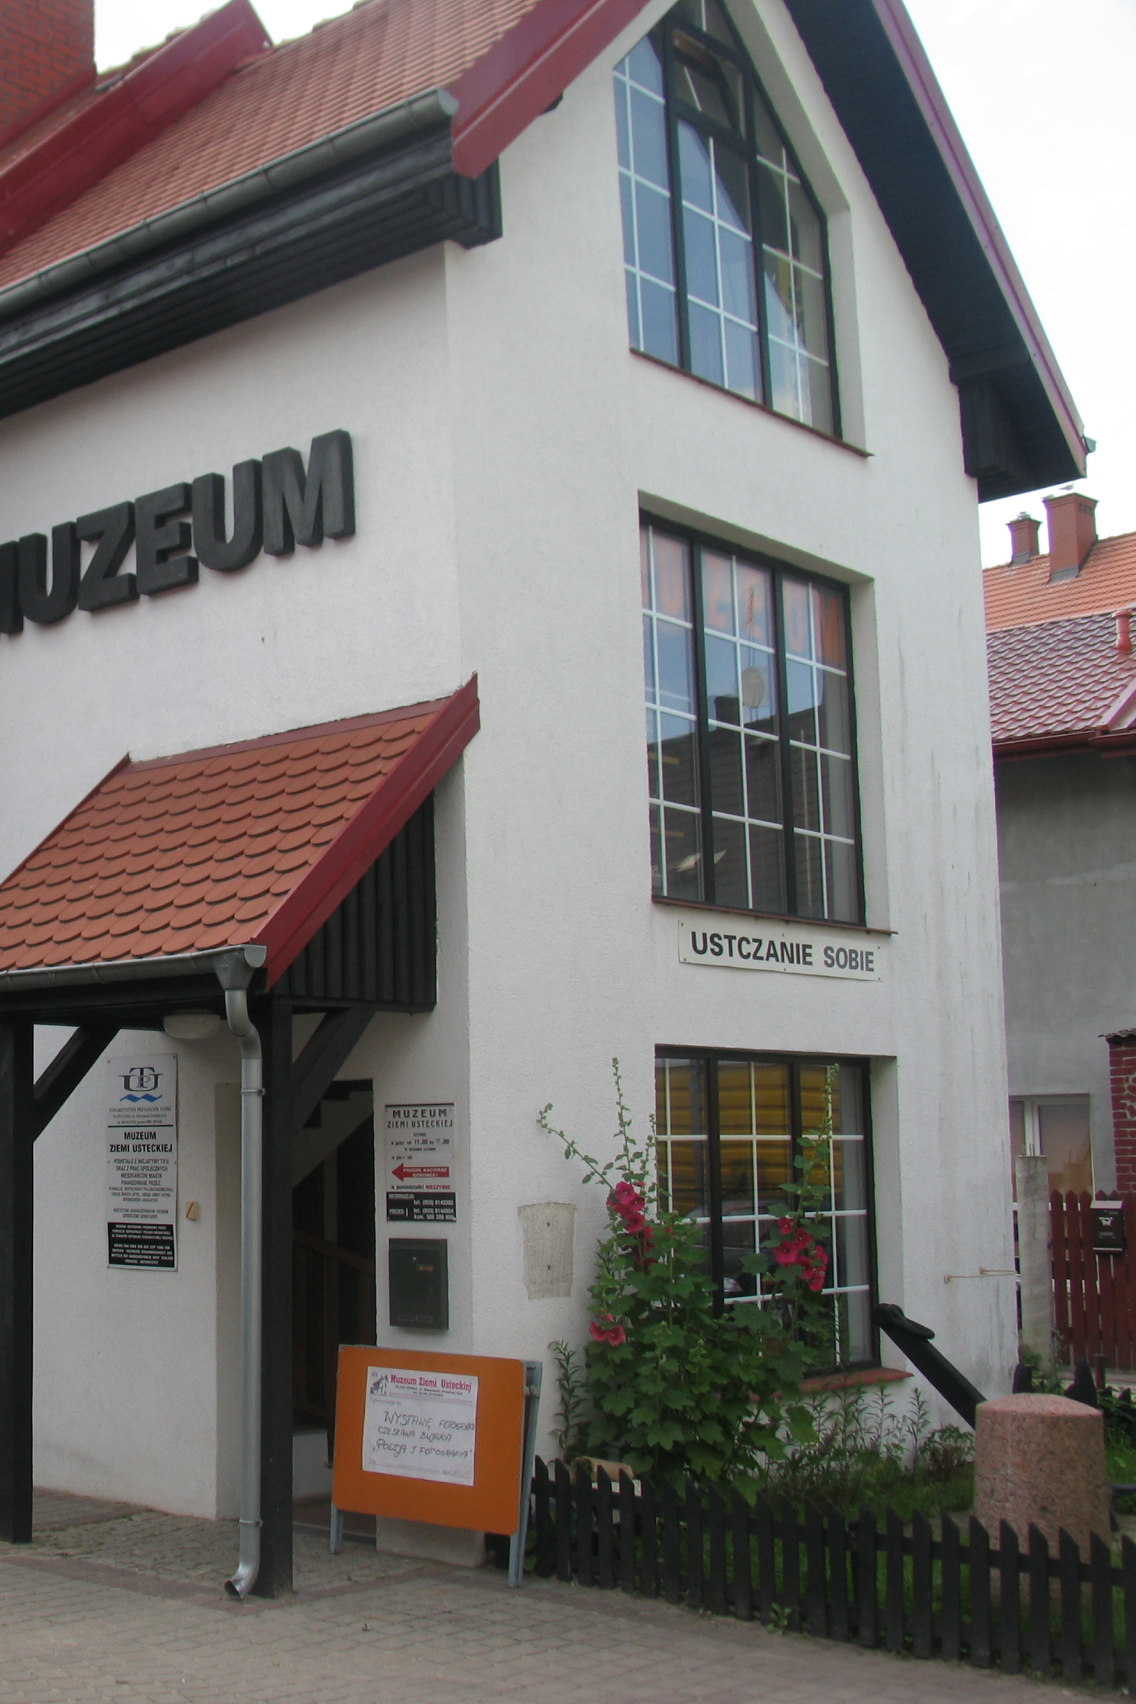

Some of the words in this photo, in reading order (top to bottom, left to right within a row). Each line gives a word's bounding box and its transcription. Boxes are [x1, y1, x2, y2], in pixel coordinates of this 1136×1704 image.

[690, 930, 814, 966] USTCZANIE
[822, 945, 875, 973] SOBIE
[392, 1108, 447, 1119] MUZEUM
[387, 1120, 409, 1129] ZIEMI
[411, 1119, 453, 1128] USTECKIEJ
[123, 1131, 157, 1140] MUZEUM
[109, 1144, 130, 1153] ZIEMI
[132, 1143, 173, 1153] USTECKIEJ
[390, 1374, 417, 1386] Muzeum
[418, 1377, 437, 1388] Ziemi
[440, 1380, 472, 1393] Usteckiej
